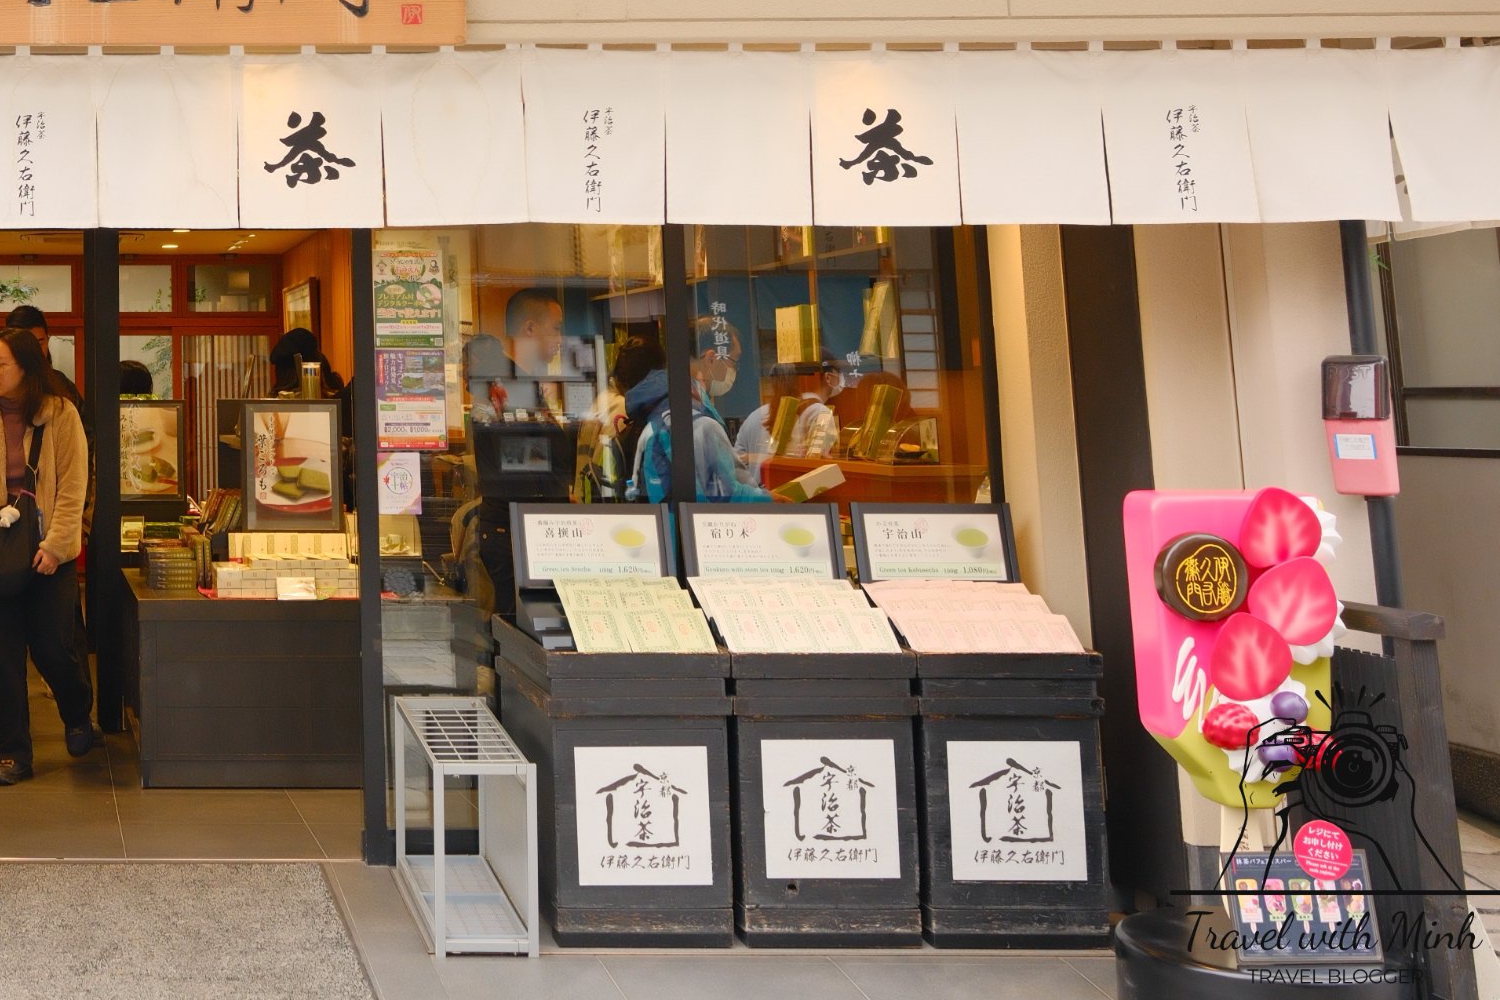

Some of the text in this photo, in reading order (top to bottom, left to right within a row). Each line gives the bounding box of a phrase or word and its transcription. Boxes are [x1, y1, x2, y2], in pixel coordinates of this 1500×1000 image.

[36, 111, 46, 140] 宇治茶
[1188, 104, 1200, 133] 宇治茶
[264, 111, 356, 188] 茶
[839, 108, 934, 185] 茶
[15, 114, 35, 217] 伊藤久右衛門
[583, 110, 602, 212] 伊藤久右衛門
[1166, 108, 1198, 212] 伊藤久右衛門
[545, 527, 583, 538] 喜撰山
[710, 528, 749, 539] 宿り木
[882, 528, 922, 540] 宇治山
[660, 772, 671, 798] 京都
[846, 764, 858, 791] 京都
[1032, 766, 1044, 792] 京都
[633, 779, 653, 841] 宇治茶
[820, 771, 841, 834] 宇治茶
[1006, 772, 1027, 836] 宇治茶
[1303, 836, 1343, 851] お申し付け
[1308, 826, 1341, 839] レジにて
[600, 854, 690, 870] 伊藤久右衛門
[787, 847, 878, 863] 伊藤久右衛門
[974, 849, 1065, 865] 伊藤久右衛門
[1307, 848, 1340, 860] ください
